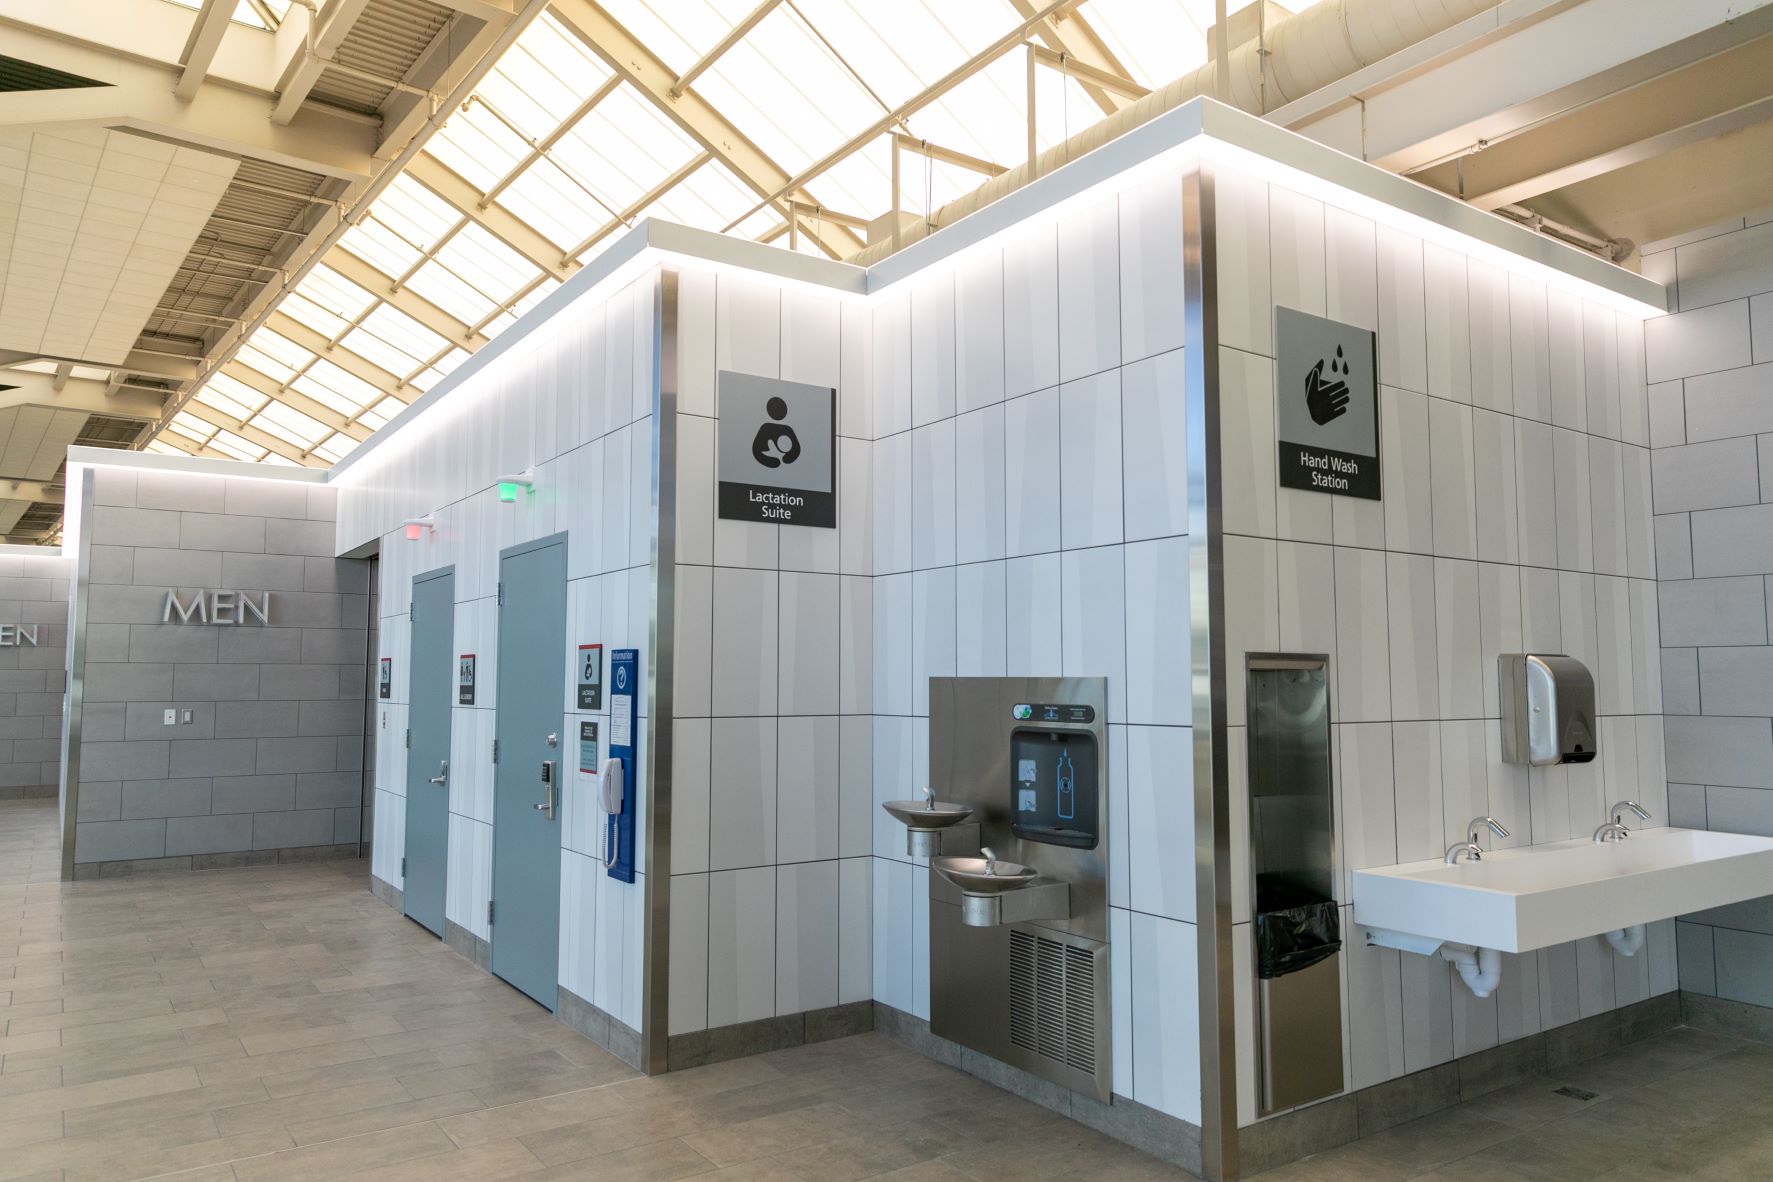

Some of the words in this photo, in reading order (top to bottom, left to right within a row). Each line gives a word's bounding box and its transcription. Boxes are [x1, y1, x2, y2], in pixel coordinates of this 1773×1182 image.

[1300, 451, 1328, 469] Hand
[1330, 456, 1358, 474] Wash
[1312, 471, 1348, 490] Station
[749, 490, 804, 506] Lactation
[761, 505, 791, 519] Suite
[162, 587, 270, 625] MEN
